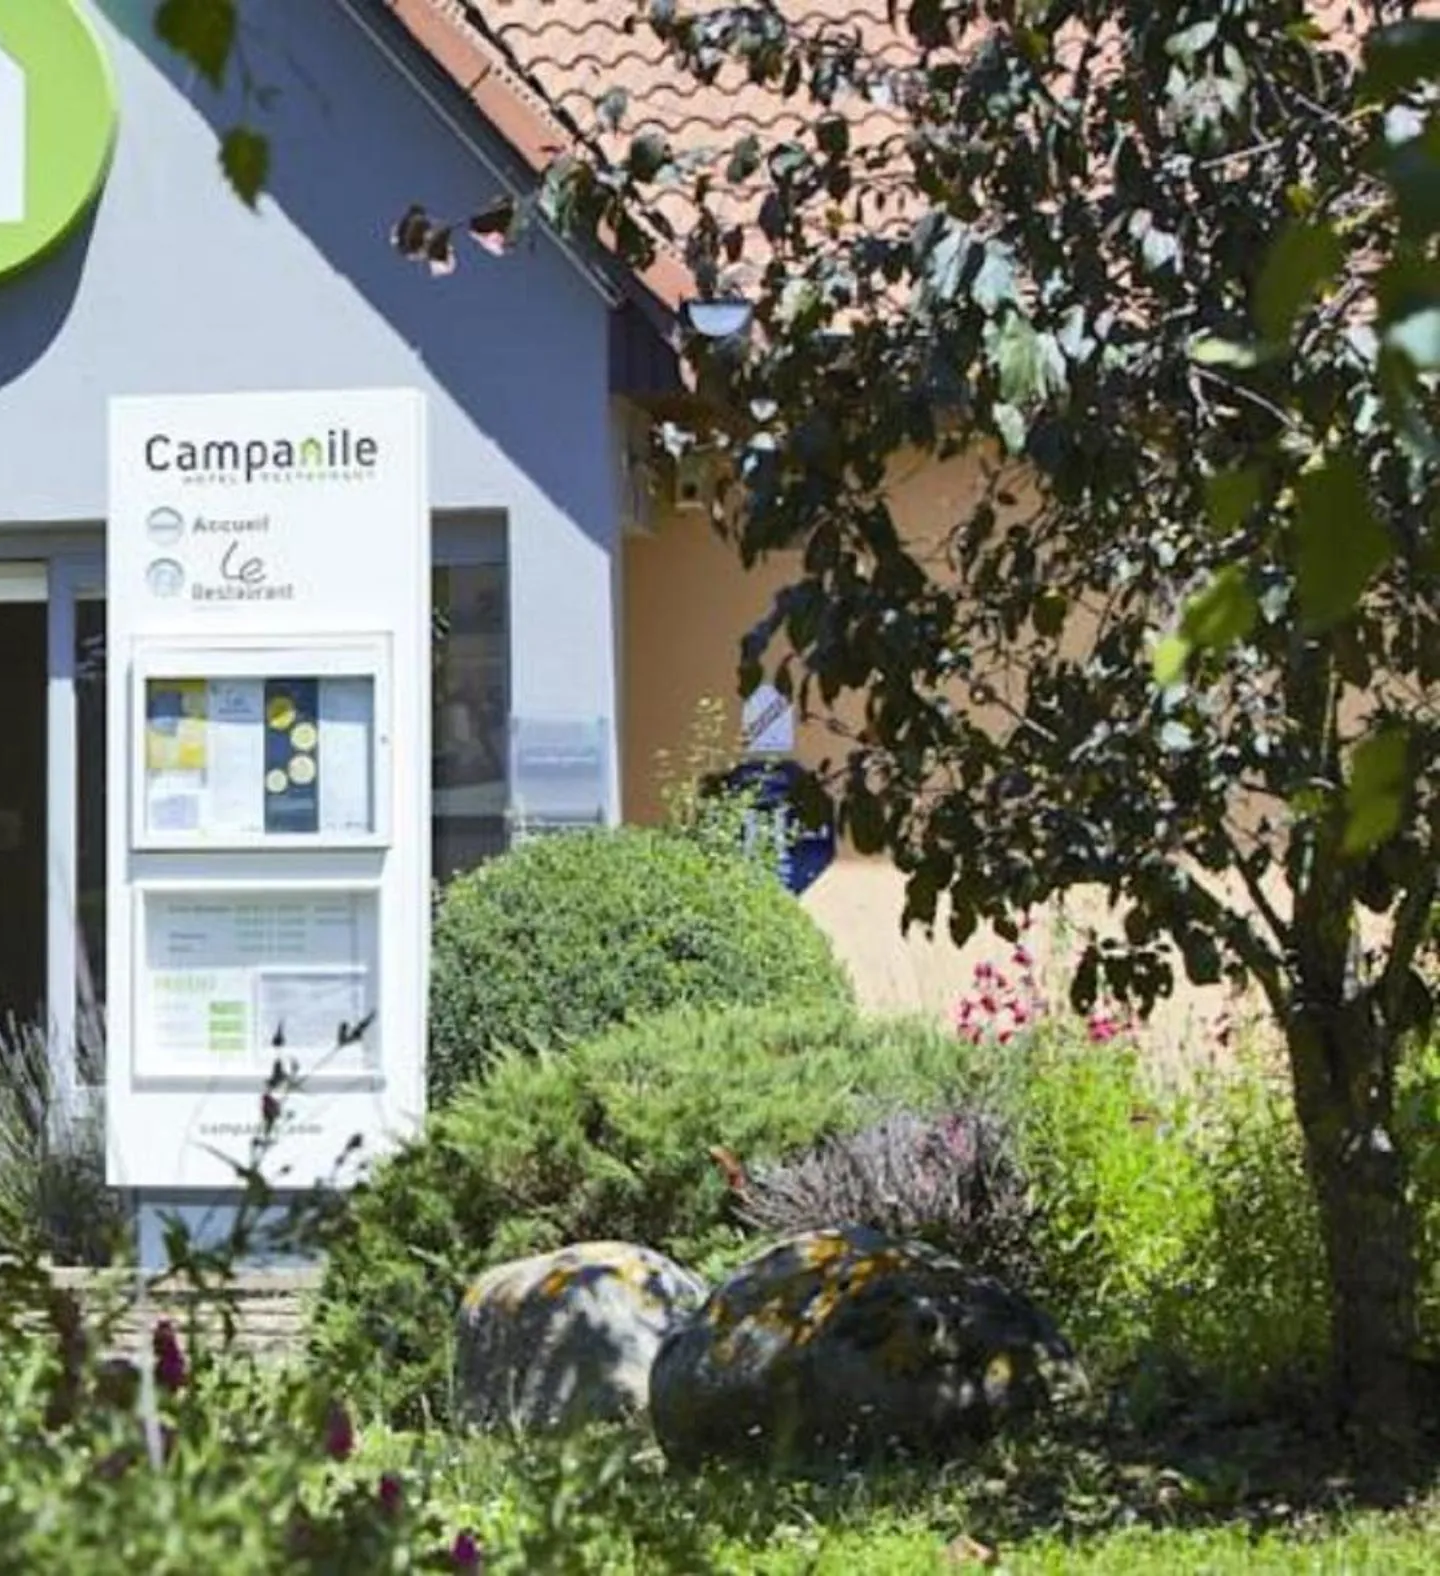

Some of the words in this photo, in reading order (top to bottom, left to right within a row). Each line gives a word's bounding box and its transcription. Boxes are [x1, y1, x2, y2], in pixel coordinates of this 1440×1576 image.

[145, 430, 378, 482] Campanile
[192, 514, 269, 533] Accueil
[219, 539, 267, 584] Le
[191, 583, 293, 601] Restaurant
